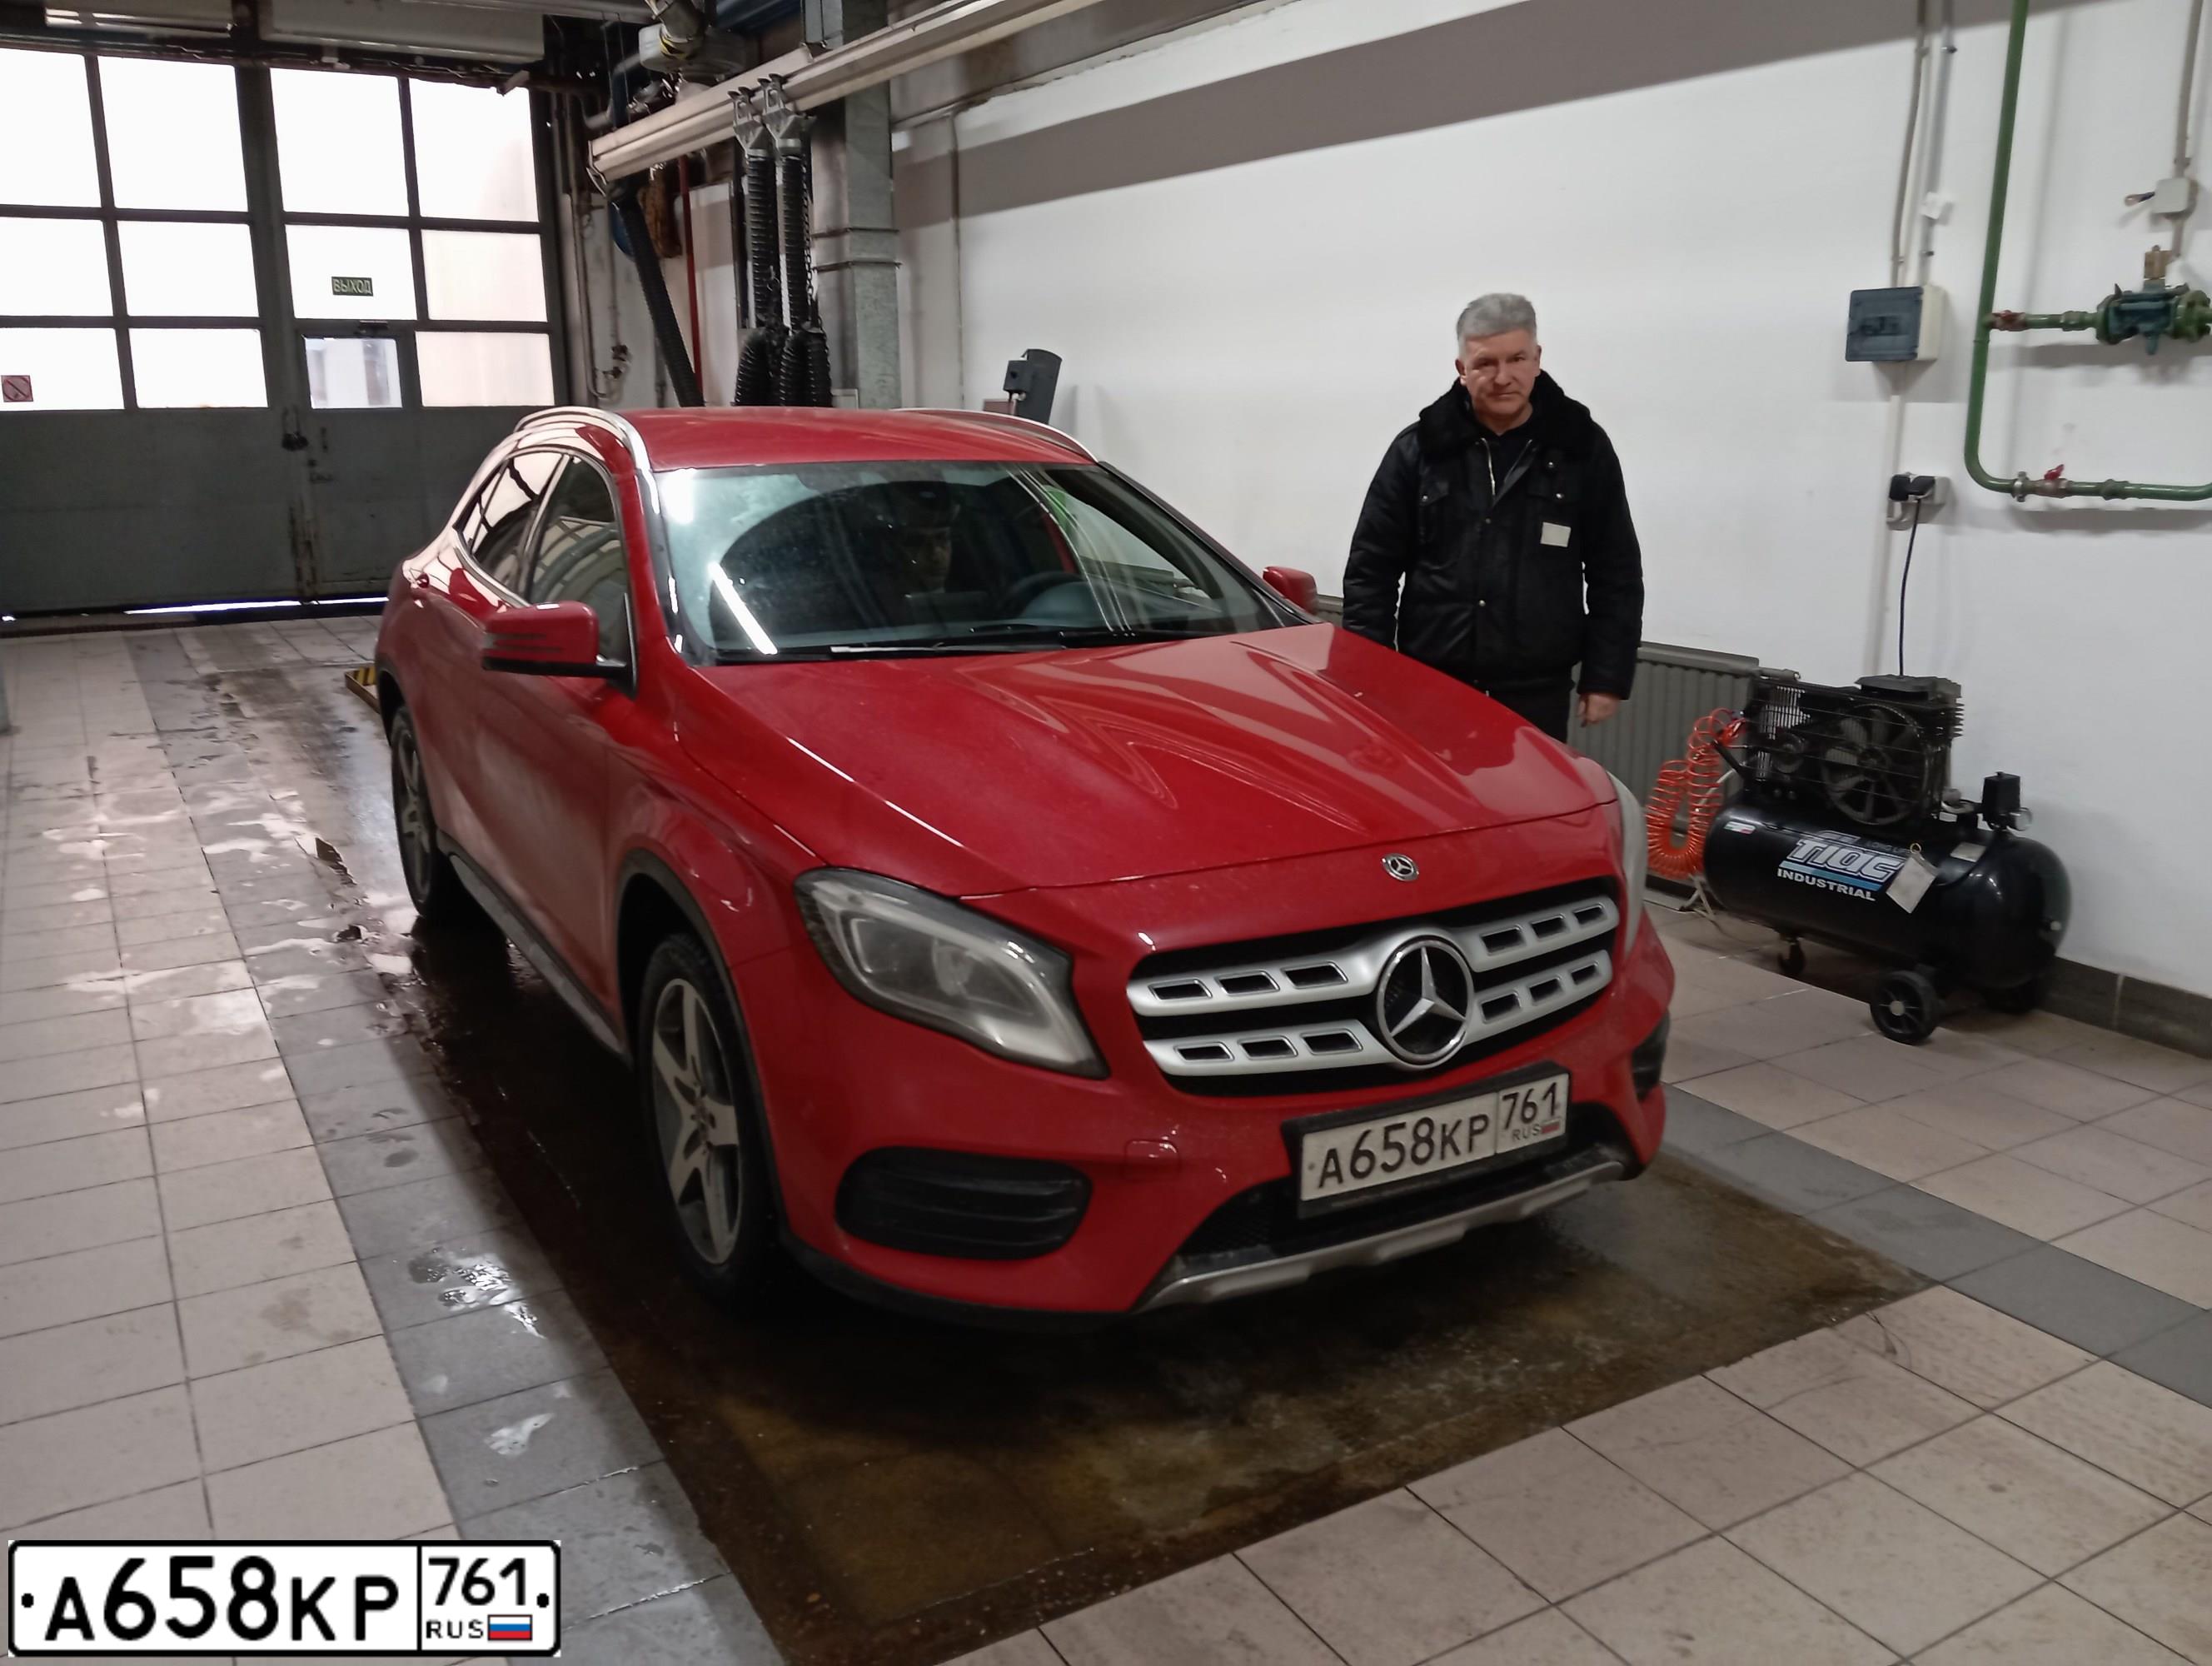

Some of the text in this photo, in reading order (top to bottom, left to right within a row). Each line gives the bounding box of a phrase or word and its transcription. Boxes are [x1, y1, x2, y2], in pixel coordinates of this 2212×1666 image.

[333, 279, 372, 294] ВЫХОД
[1777, 868, 1876, 900] INDUSTRIAL
[1502, 1082, 1559, 1130] 761
[1512, 1124, 1541, 1142] RUS
[1318, 1115, 1489, 1189] А658КР
